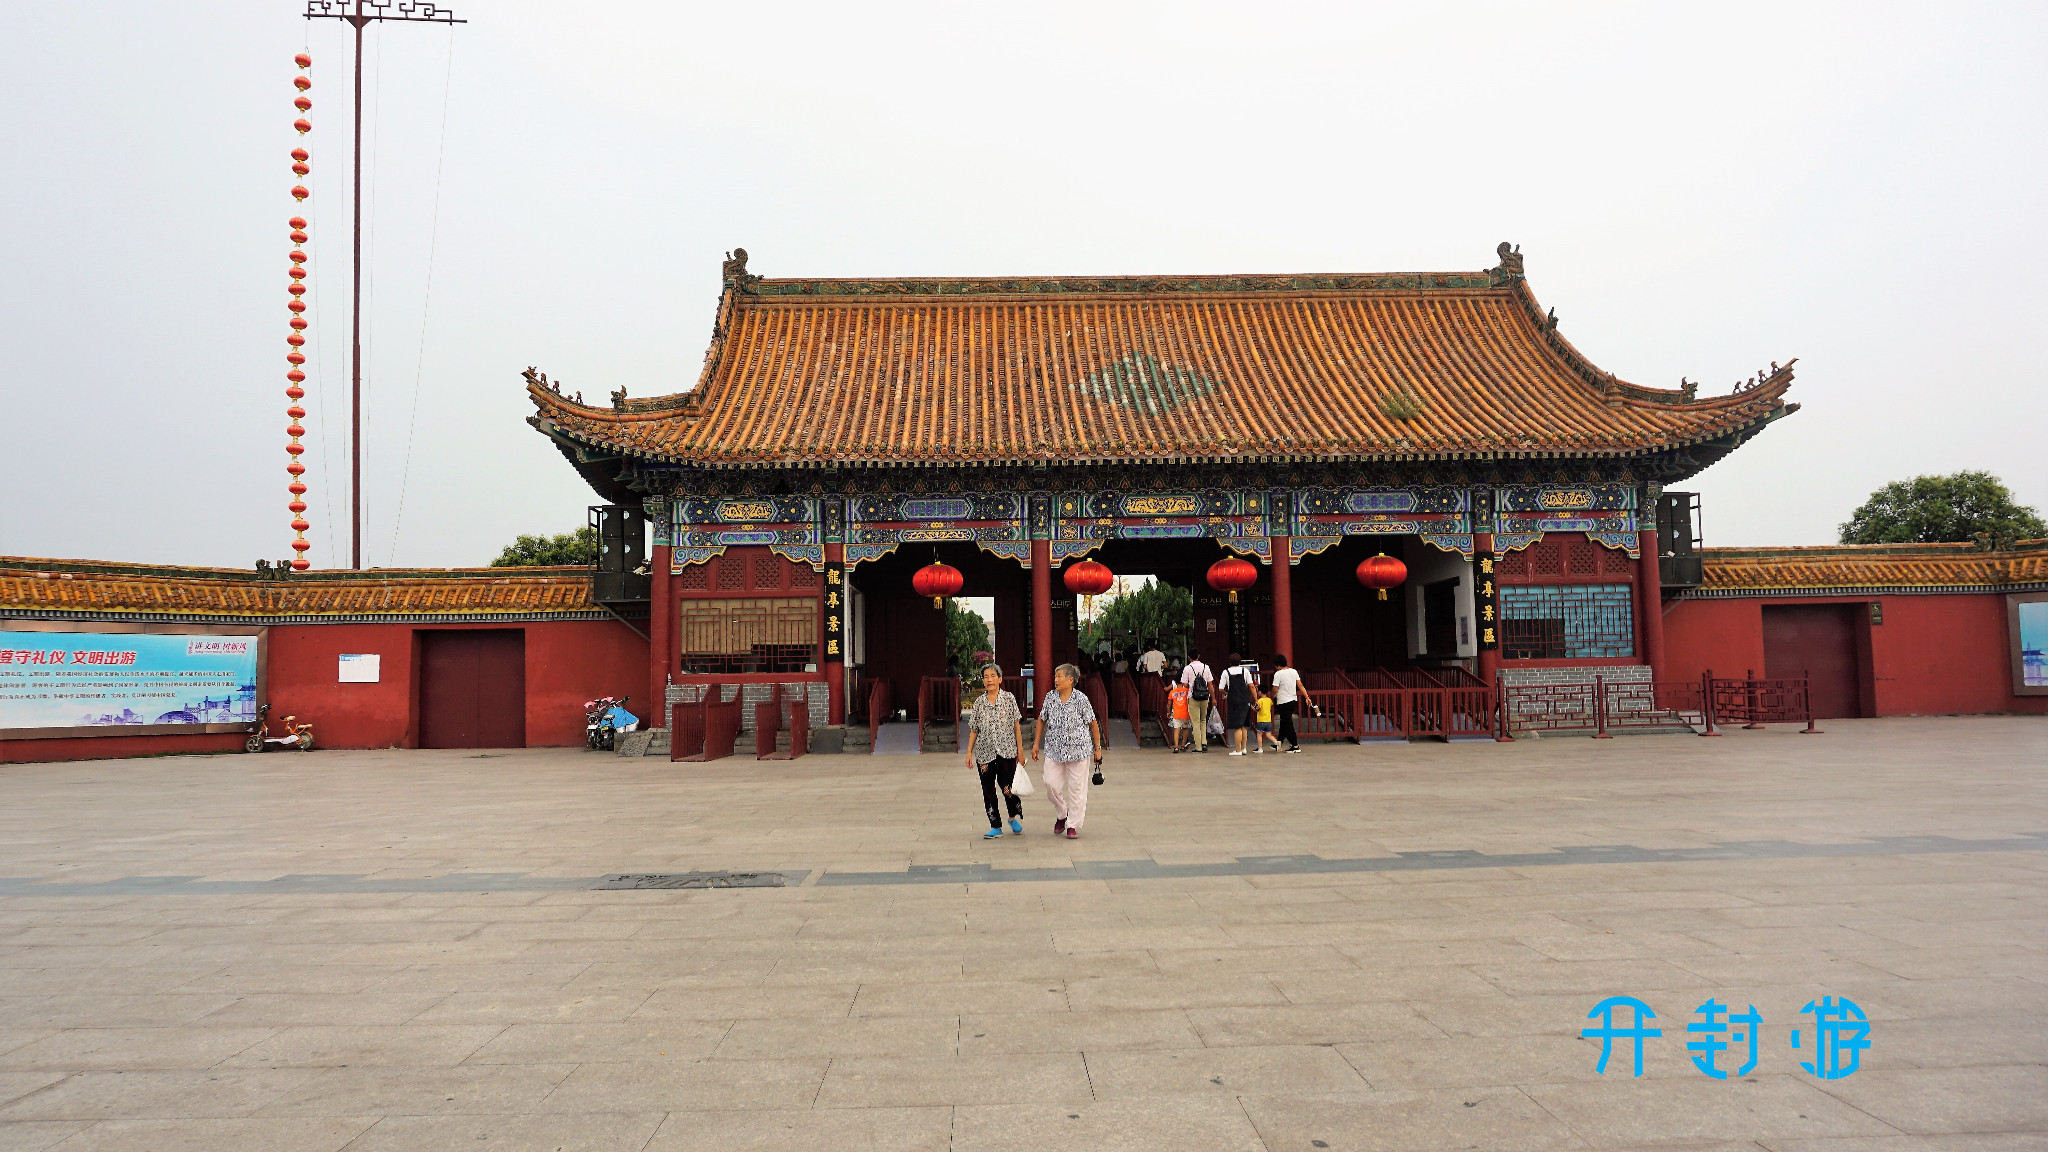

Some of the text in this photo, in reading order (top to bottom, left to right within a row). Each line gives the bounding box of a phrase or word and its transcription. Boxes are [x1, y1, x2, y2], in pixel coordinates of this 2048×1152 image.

[827, 568, 841, 655] 龍亭景區
[1480, 558, 1495, 643] 龍亭景區
[0, 649, 137, 665] 遵守礼仪 文明出游
